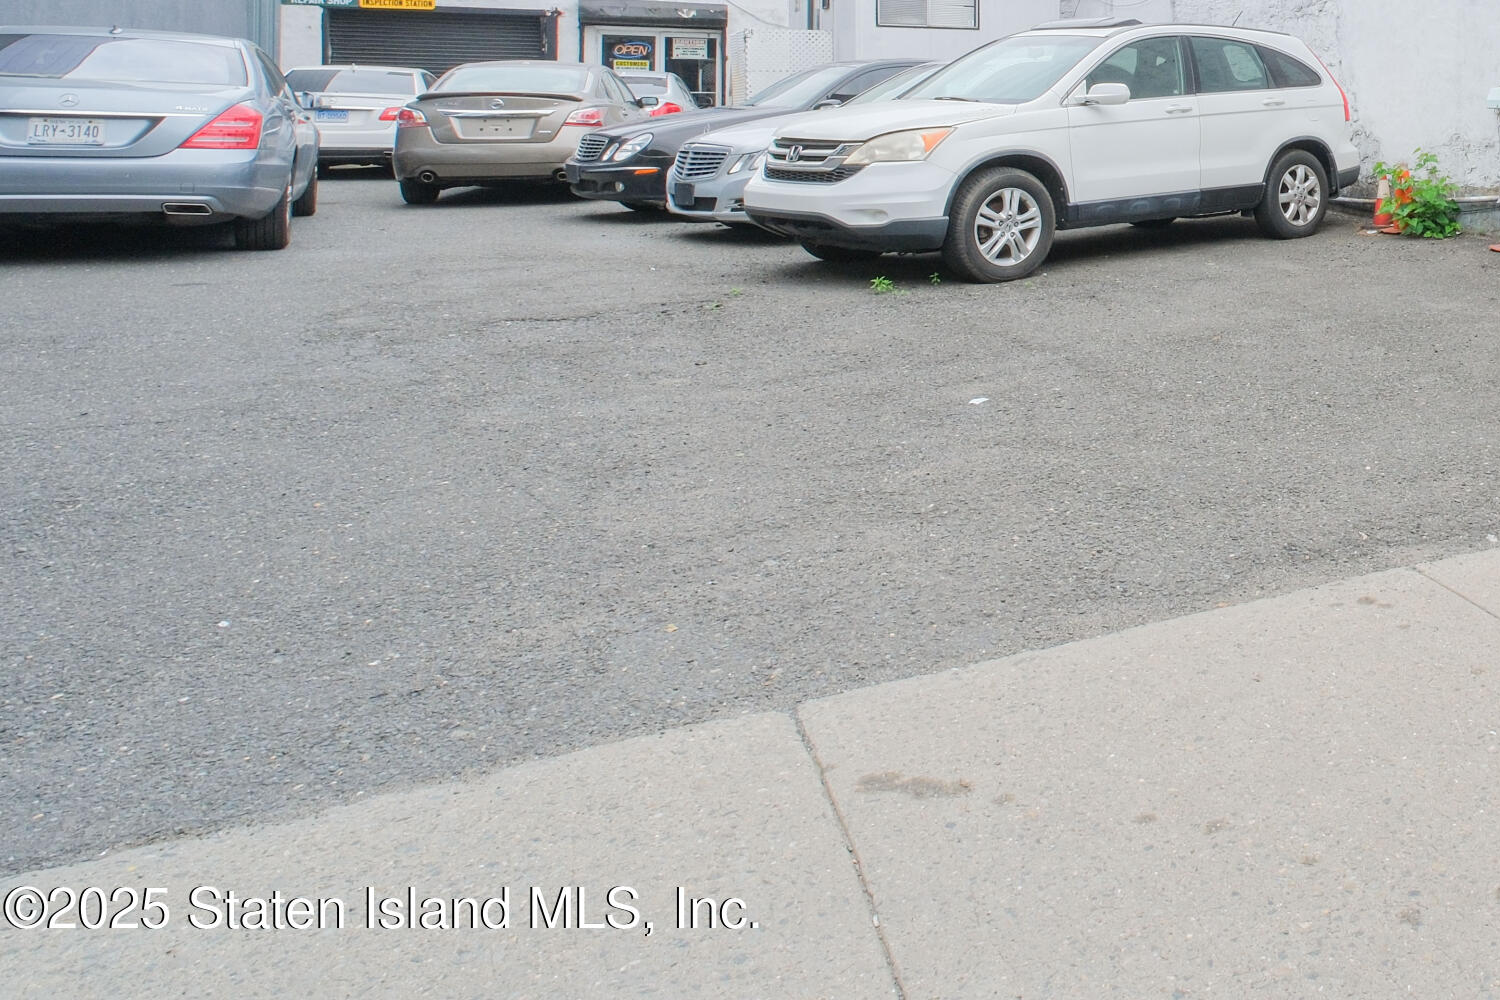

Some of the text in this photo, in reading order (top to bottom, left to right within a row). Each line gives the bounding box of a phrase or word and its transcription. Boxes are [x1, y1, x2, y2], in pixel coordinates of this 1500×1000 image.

[406, 0, 432, 8] STATION
[614, 44, 648, 56] OPEN
[34, 124, 99, 138] LRY-3140
